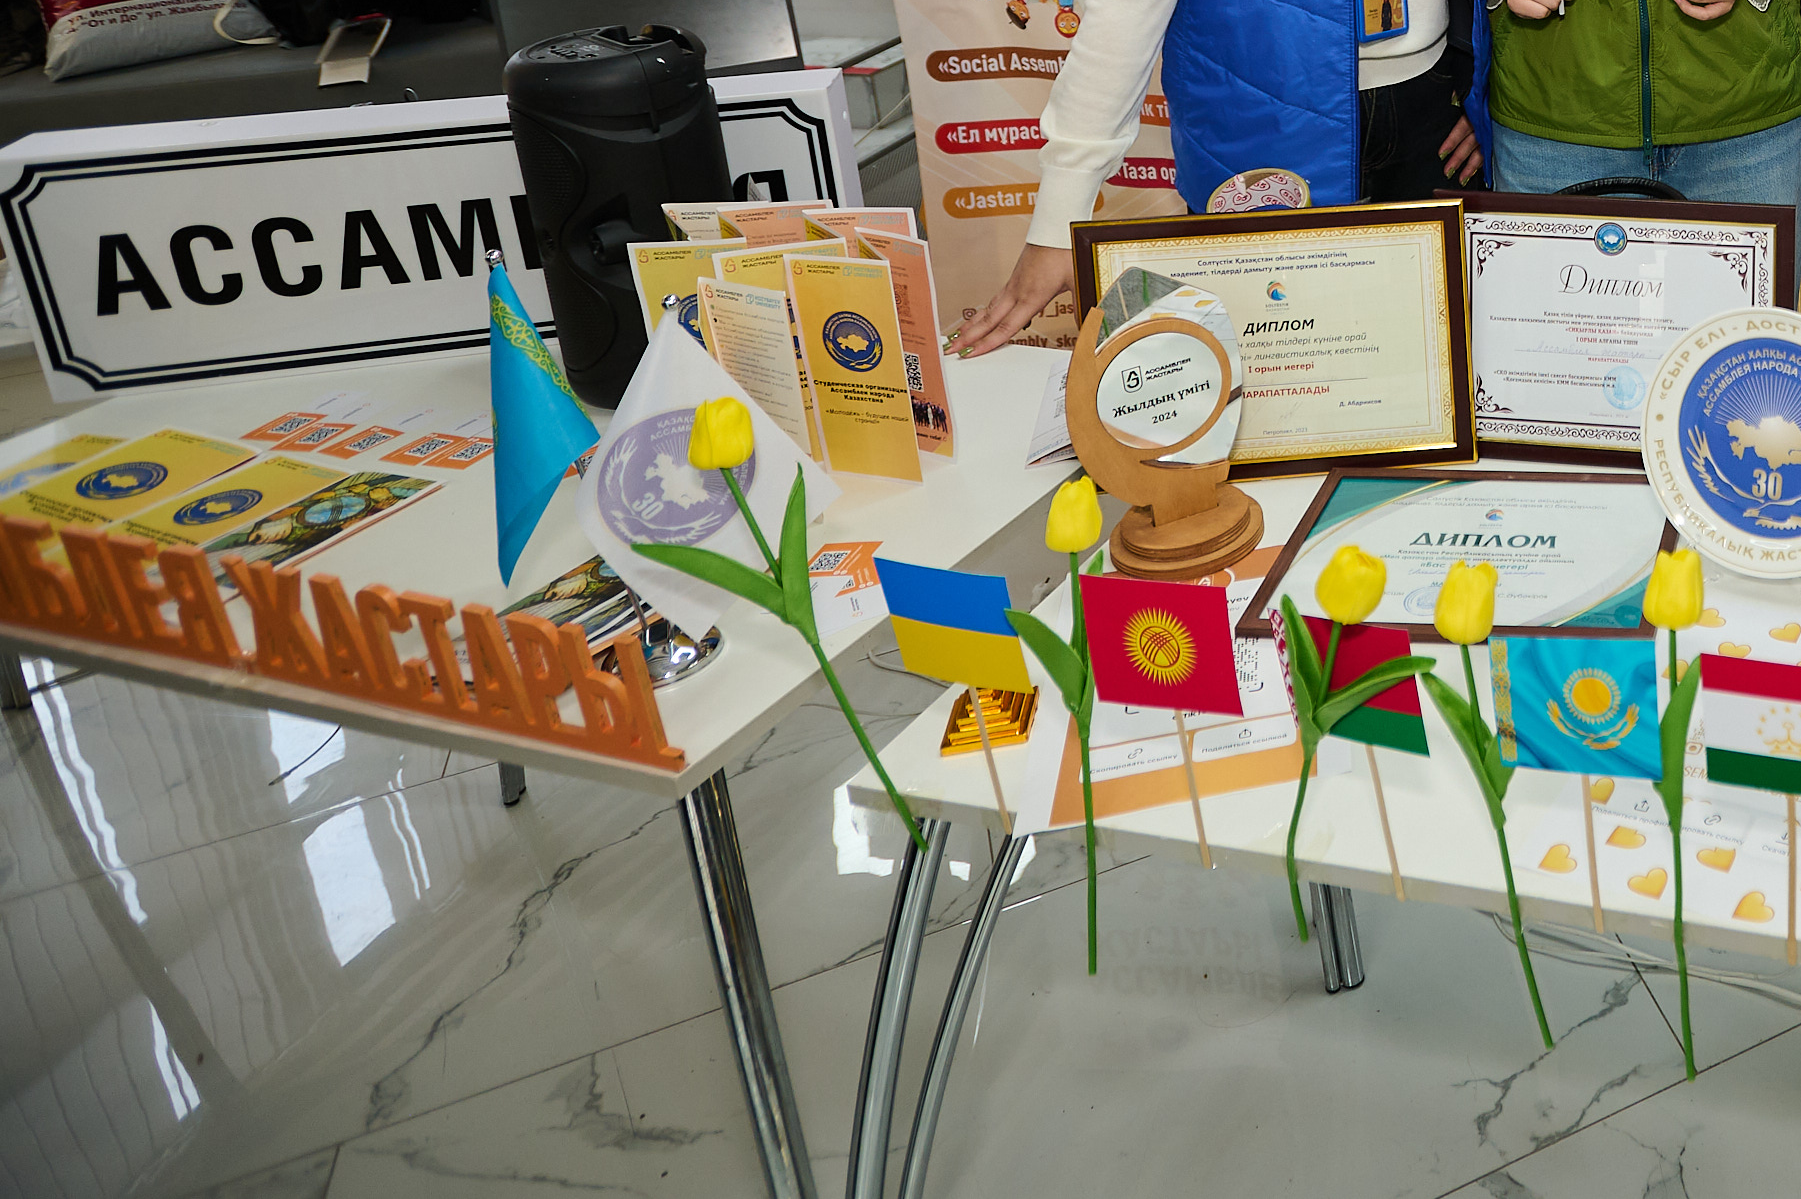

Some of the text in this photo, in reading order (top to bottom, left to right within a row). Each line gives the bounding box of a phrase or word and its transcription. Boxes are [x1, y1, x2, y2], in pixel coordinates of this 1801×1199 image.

[937, 53, 1006, 75] «Social
[946, 125, 982, 147] «Ел
[954, 189, 1023, 211] «Jastar
[1197, 257, 1234, 268] Солтүстік
[1235, 255, 1274, 266] Қазақстан
[1274, 253, 1306, 262] облысы
[1210, 267, 1242, 276] тілдерді
[1243, 265, 1273, 275] дамыту
[1274, 263, 1294, 272] және
[1295, 262, 1318, 272] архив
[1329, 259, 1376, 269] басқармасы
[1557, 263, 1664, 300] Диплом
[1242, 318, 1315, 337] ДИПЛОМ
[1245, 332, 1367, 349] халқы тілдері күніне орай
[1254, 348, 1333, 362] лингвистикалық
[1334, 345, 1380, 356] квестінің
[1144, 357, 1192, 376] АССАМБЛЕЯ
[1254, 361, 1315, 376] орын иегері
[1659, 349, 1691, 401] «СЫР
[1695, 326, 1726, 351] ЕЛІ
[1145, 366, 1184, 382] ЖАСТАРЫ
[1696, 352, 1747, 400] ҚАЗАҚСТАН
[1747, 347, 1787, 361] ХАЛҚЫ
[813, 379, 908, 394] Студенческая организация
[869, 391, 895, 399] народа
[1702, 364, 1752, 417] АССАМБЛЕЯ
[1752, 362, 1799, 377] НАРОДА
[844, 395, 884, 404] Казахстана
[1112, 379, 1211, 419] Жылдың үміті
[1151, 410, 1178, 425] 2024
[1751, 468, 1783, 501] 30
[631, 492, 665, 521] 30
[1653, 438, 1755, 560] РЕСПУБЛИКАЛЫҚ
[1409, 532, 1558, 550] ДИПЛОМ
[219, 554, 687, 772] ЖАСТАРЫ
